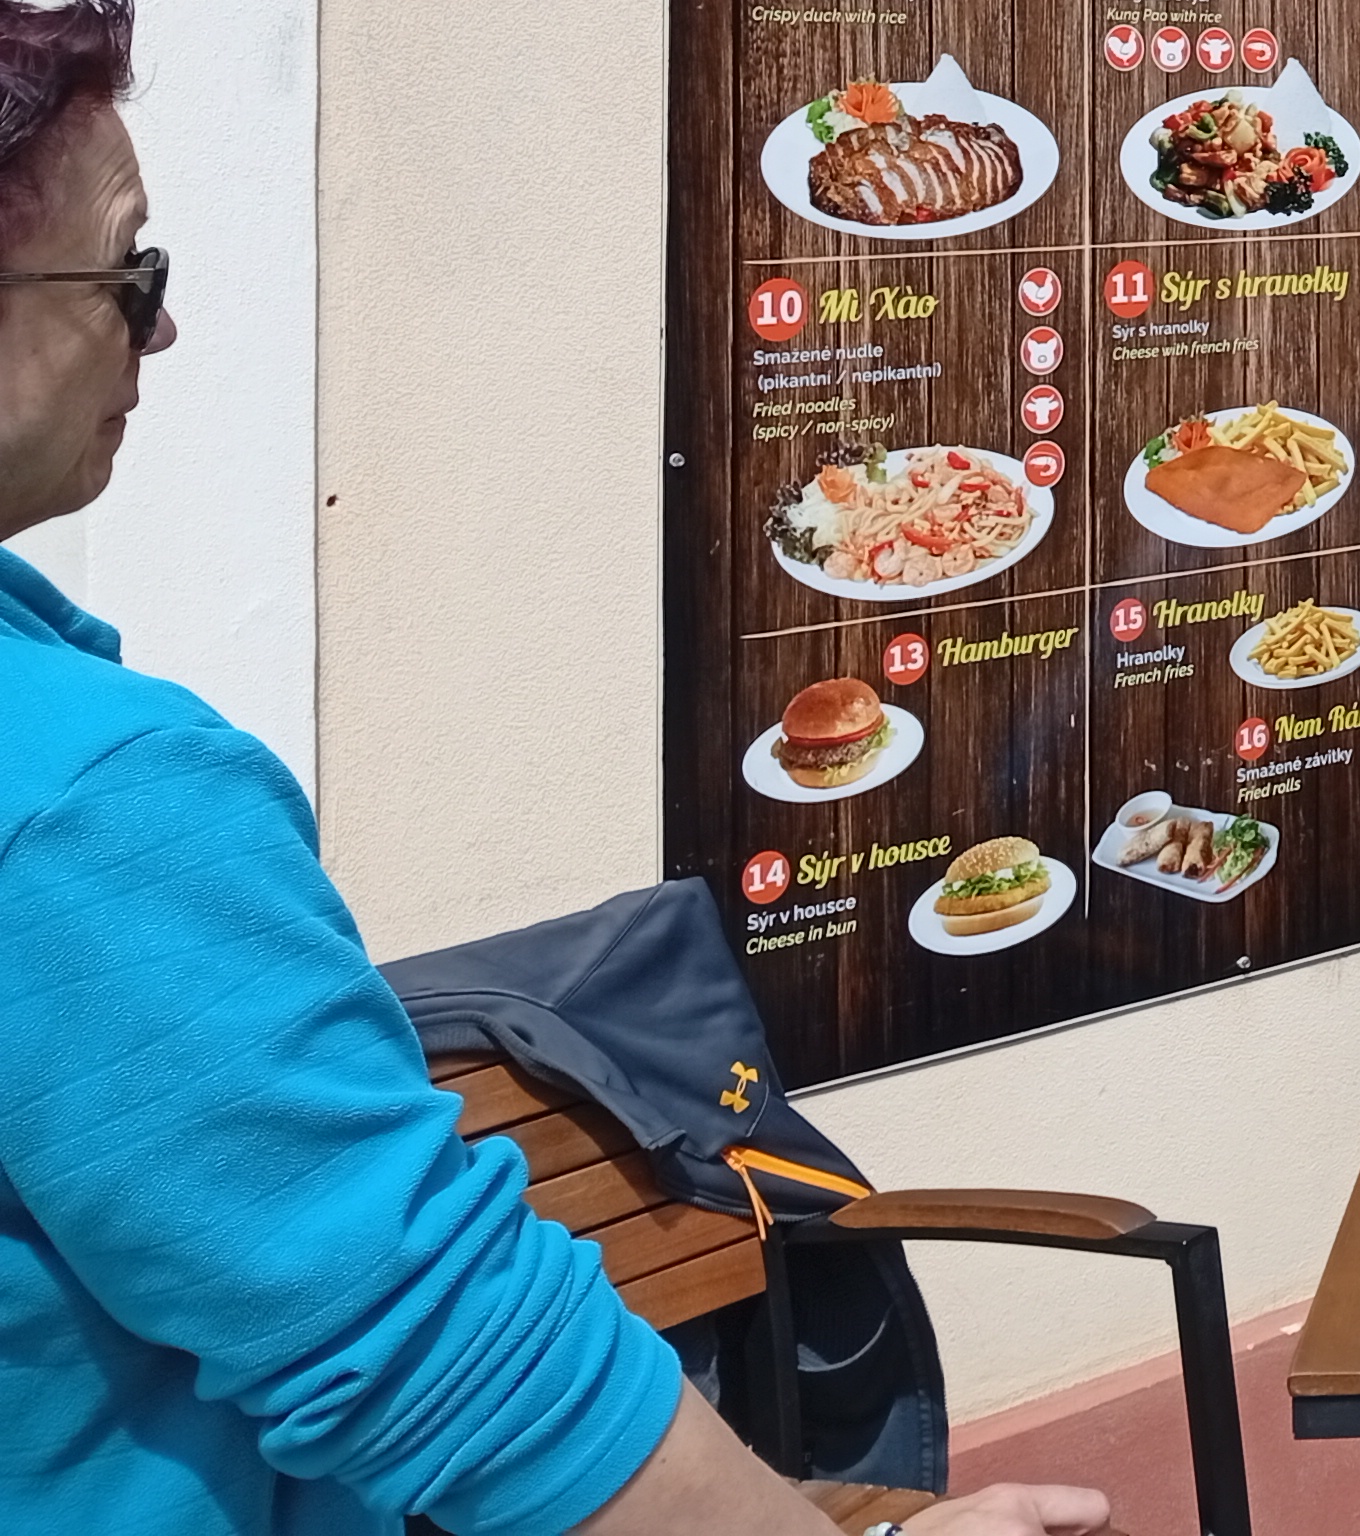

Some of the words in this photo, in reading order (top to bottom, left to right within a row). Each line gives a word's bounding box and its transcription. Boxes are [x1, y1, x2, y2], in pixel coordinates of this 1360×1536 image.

[752, 6, 800, 26] Crispy
[803, 7, 841, 23] duck
[845, 9, 876, 24] with
[879, 12, 906, 25] rice
[1111, 272, 1148, 304] 11
[1161, 270, 1210, 311] Sýr
[1215, 281, 1230, 300] s
[1236, 266, 1349, 302] hranolky
[757, 290, 801, 325] 10
[870, 285, 939, 322] Xào
[1112, 323, 1135, 341] Sýr
[1139, 326, 1146, 337] s
[1150, 320, 1209, 336] hranolky
[753, 345, 831, 366] Smažené
[836, 343, 884, 360] nudle
[1113, 346, 1159, 361] Cheese
[1162, 341, 1188, 356] with
[1191, 338, 1230, 357] french
[1233, 338, 1259, 354] fries
[753, 401, 792, 418] Fried
[795, 396, 856, 413] noodles
[753, 422, 799, 442] (spicy
[816, 413, 895, 435] non-spicy)
[1114, 606, 1143, 632] 15
[1153, 590, 1265, 629] Hranolky
[888, 642, 924, 673] 13
[937, 627, 1079, 666] Hamburger
[1117, 645, 1185, 668] Hranolky
[1114, 666, 1161, 689] French
[1164, 663, 1194, 684] fries
[1239, 728, 1266, 752] 16
[1275, 714, 1325, 744] Nem
[1236, 757, 1302, 783] Smažené
[1304, 747, 1353, 769] závitky
[1237, 783, 1270, 803] Fried
[1272, 779, 1301, 796] rolls
[748, 859, 786, 892] 14
[797, 850, 846, 889] Sýr
[851, 852, 865, 874] v
[869, 835, 952, 870] housce
[747, 911, 776, 933] Sýr
[780, 910, 790, 923] v
[794, 896, 857, 921] housce
[746, 930, 804, 955] Cheese
[808, 925, 823, 942] in
[826, 919, 857, 938] bun
